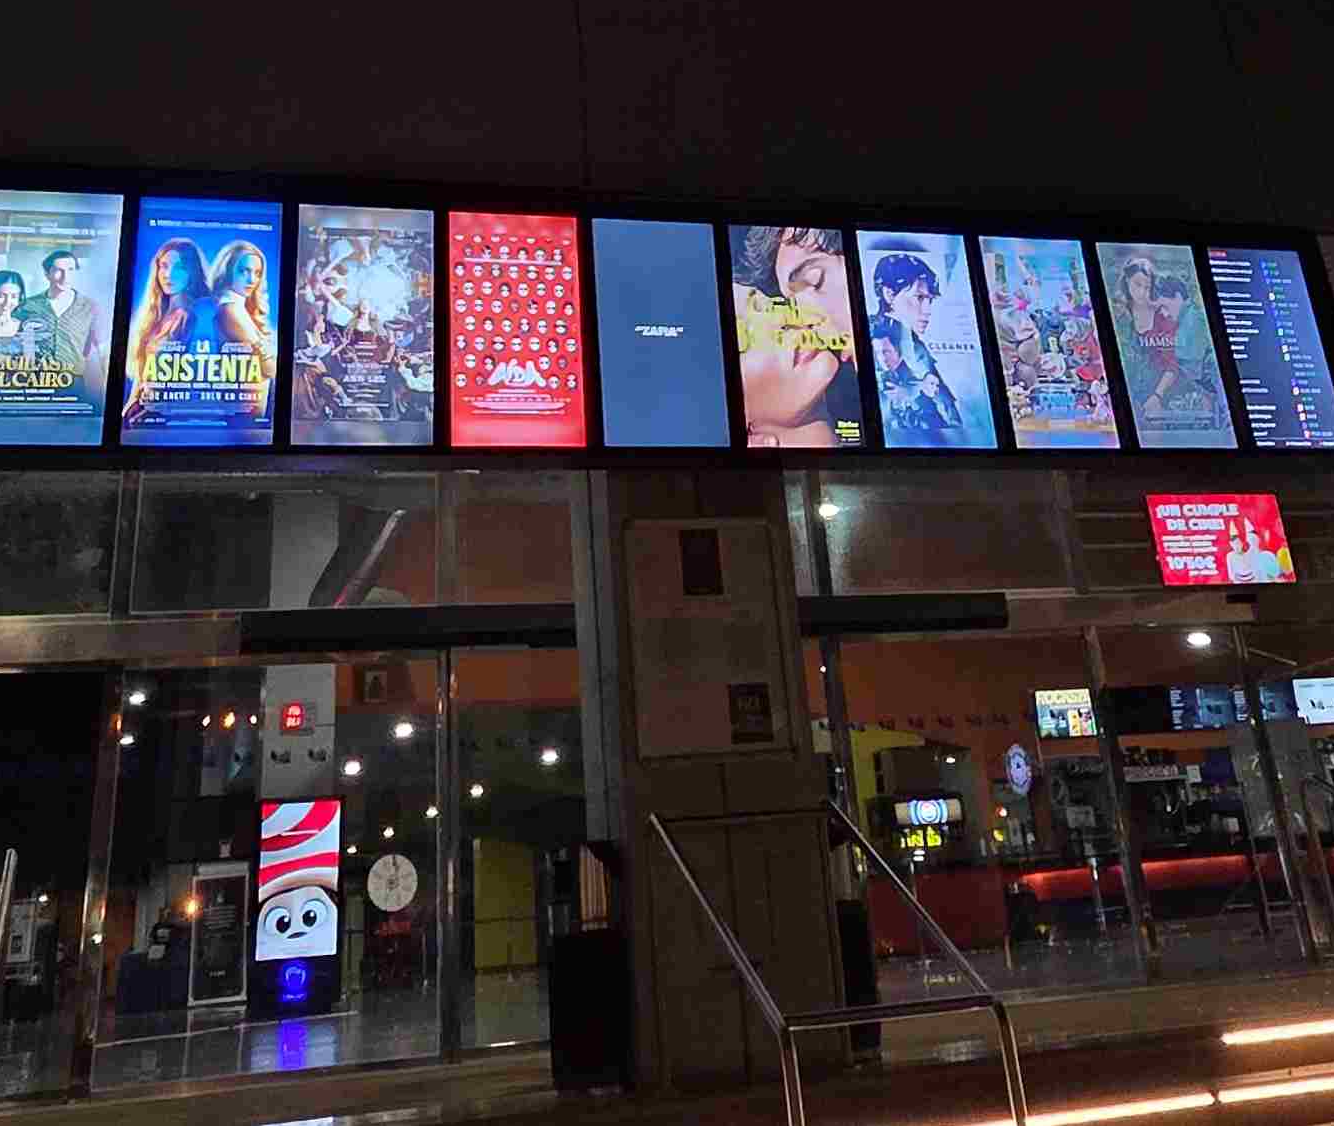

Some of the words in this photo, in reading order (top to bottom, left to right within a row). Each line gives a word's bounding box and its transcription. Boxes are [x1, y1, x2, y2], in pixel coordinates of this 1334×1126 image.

[196, 339, 210, 353] LA
[144, 353, 262, 382] ASISTENTA
[12, 372, 74, 388] CAIRO
